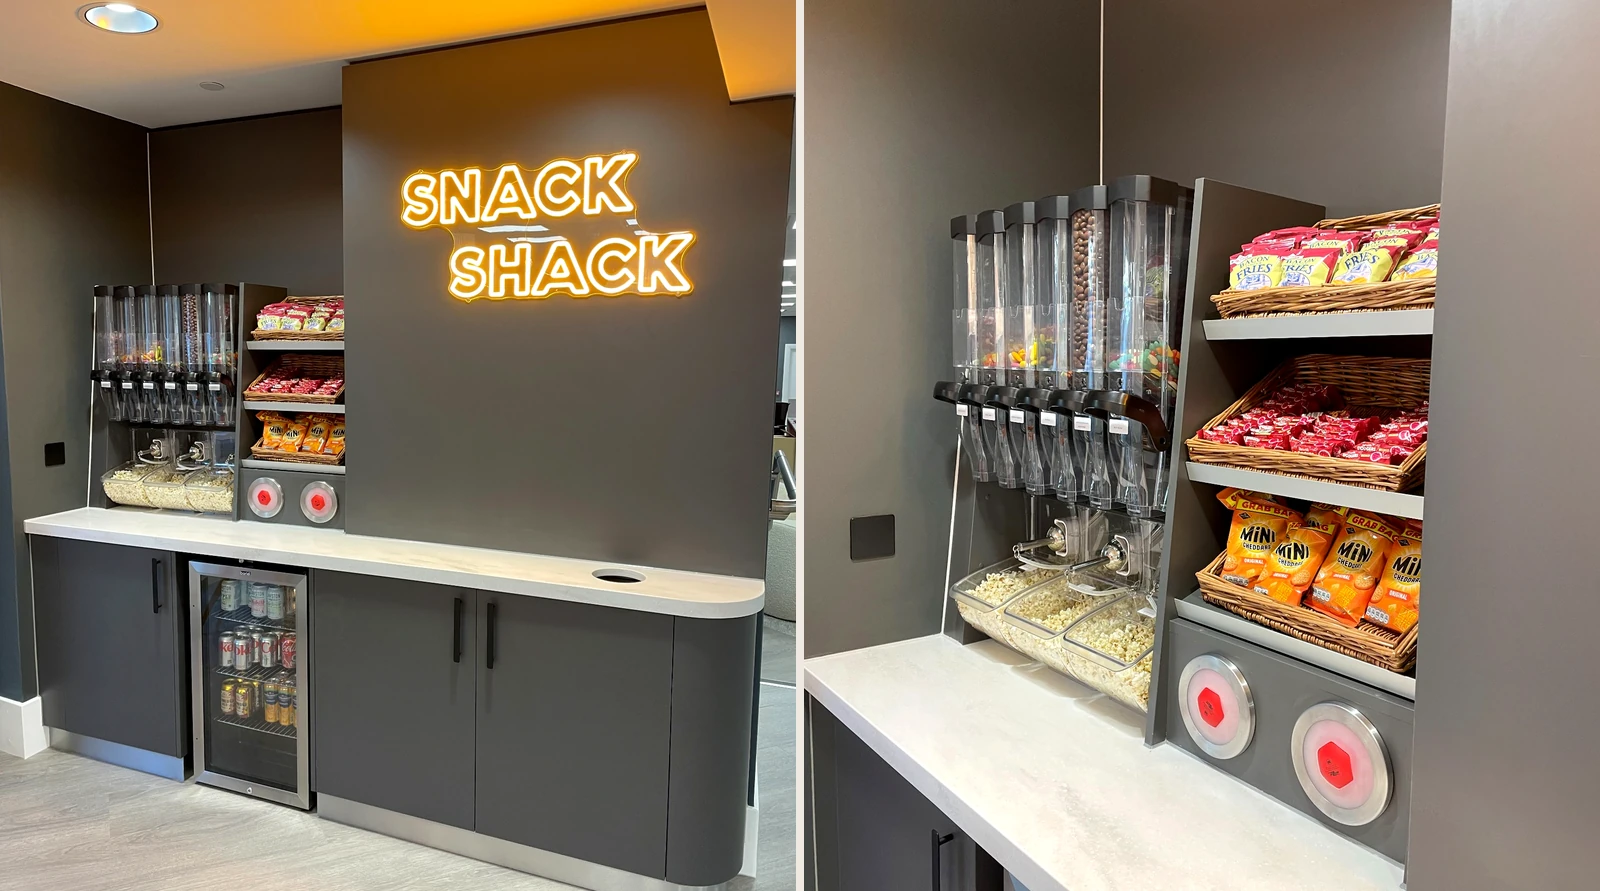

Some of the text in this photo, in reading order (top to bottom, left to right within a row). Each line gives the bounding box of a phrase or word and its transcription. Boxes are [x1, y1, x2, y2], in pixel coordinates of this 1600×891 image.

[402, 152, 637, 227] SNACK
[449, 232, 694, 298] SHACK
[1240, 256, 1270, 269] BACON
[1344, 251, 1381, 270] FRIES
[1236, 263, 1273, 281] FRIES
[1241, 500, 1271, 513] GRAB
[1351, 515, 1399, 541] GRAB BAG
[1243, 541, 1272, 551] CHEDDARS
[1388, 589, 1408, 601] ORIGINAL
